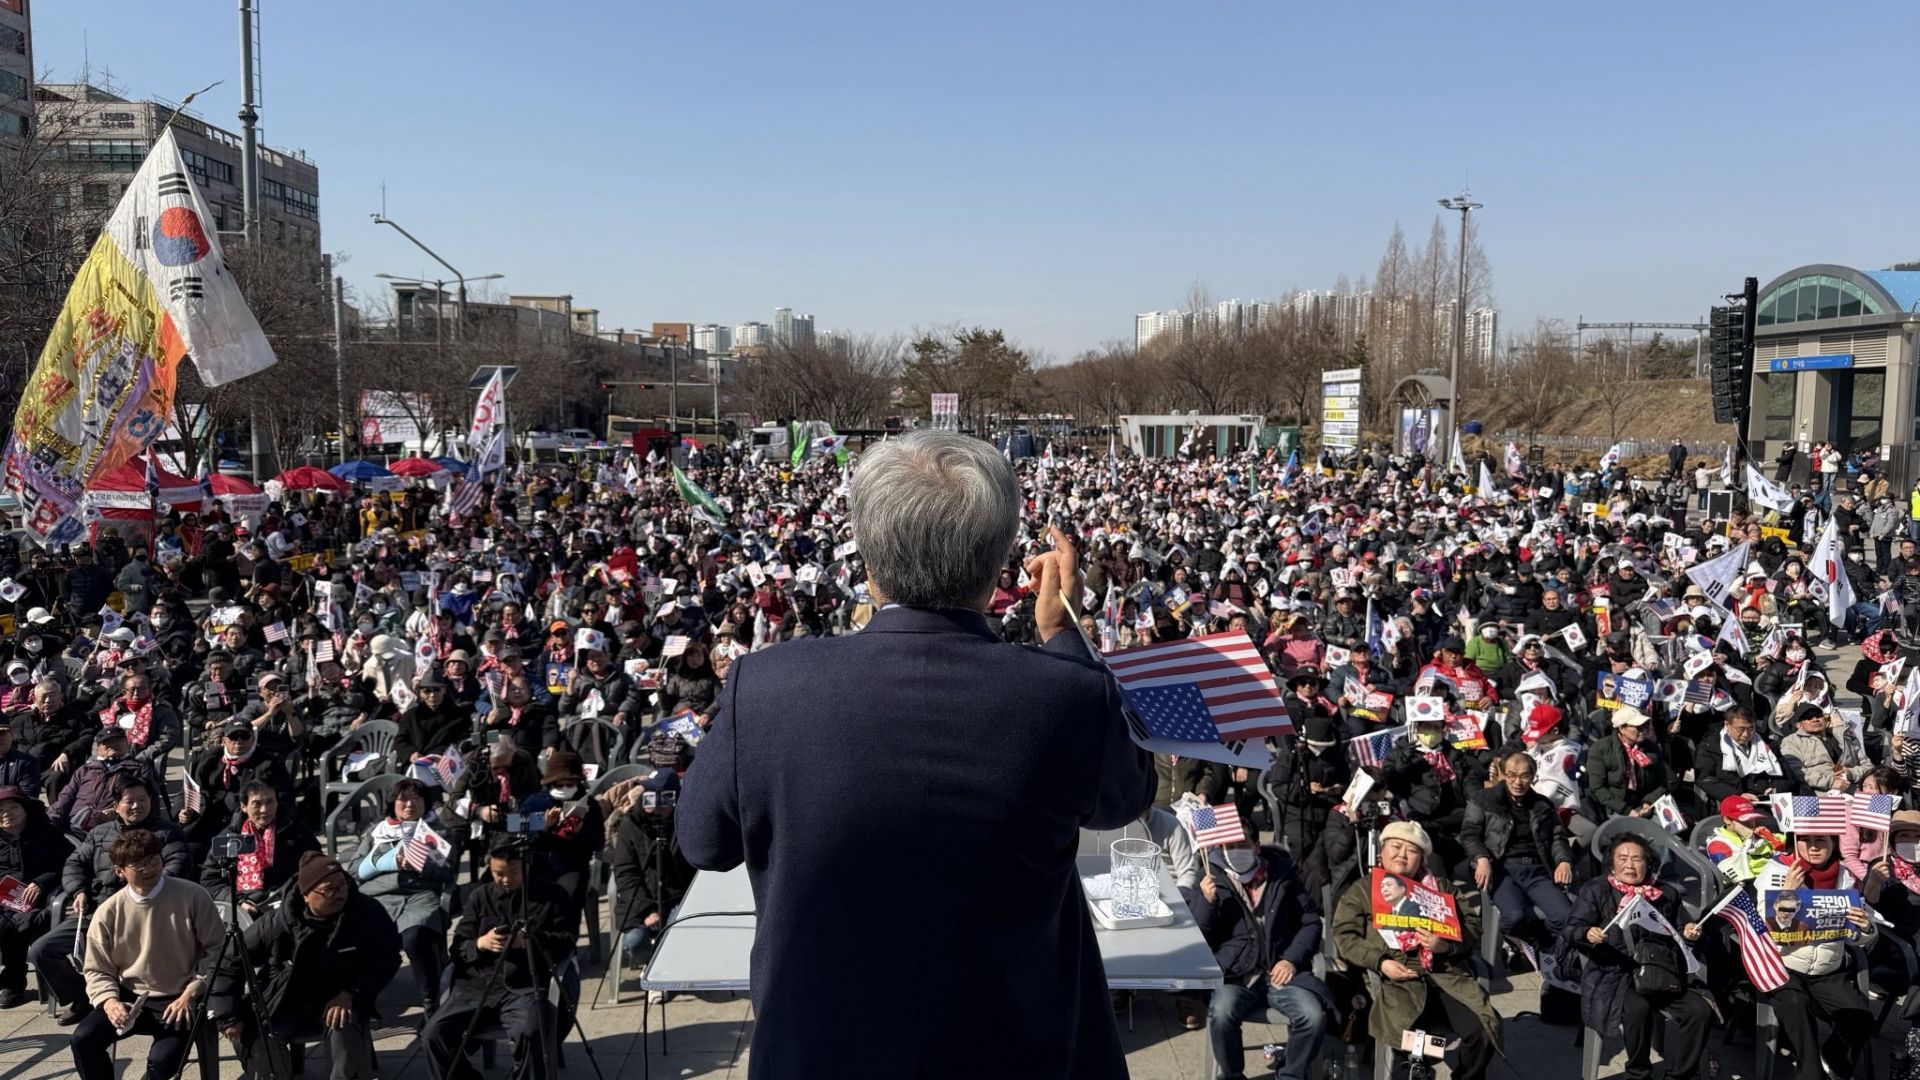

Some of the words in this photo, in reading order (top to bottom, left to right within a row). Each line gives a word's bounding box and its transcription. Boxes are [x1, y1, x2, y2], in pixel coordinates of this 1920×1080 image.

[1811, 895, 1851, 909] 국민이
[1805, 908, 1848, 919] 지켜보
[1815, 918, 1846, 929] 있다!
